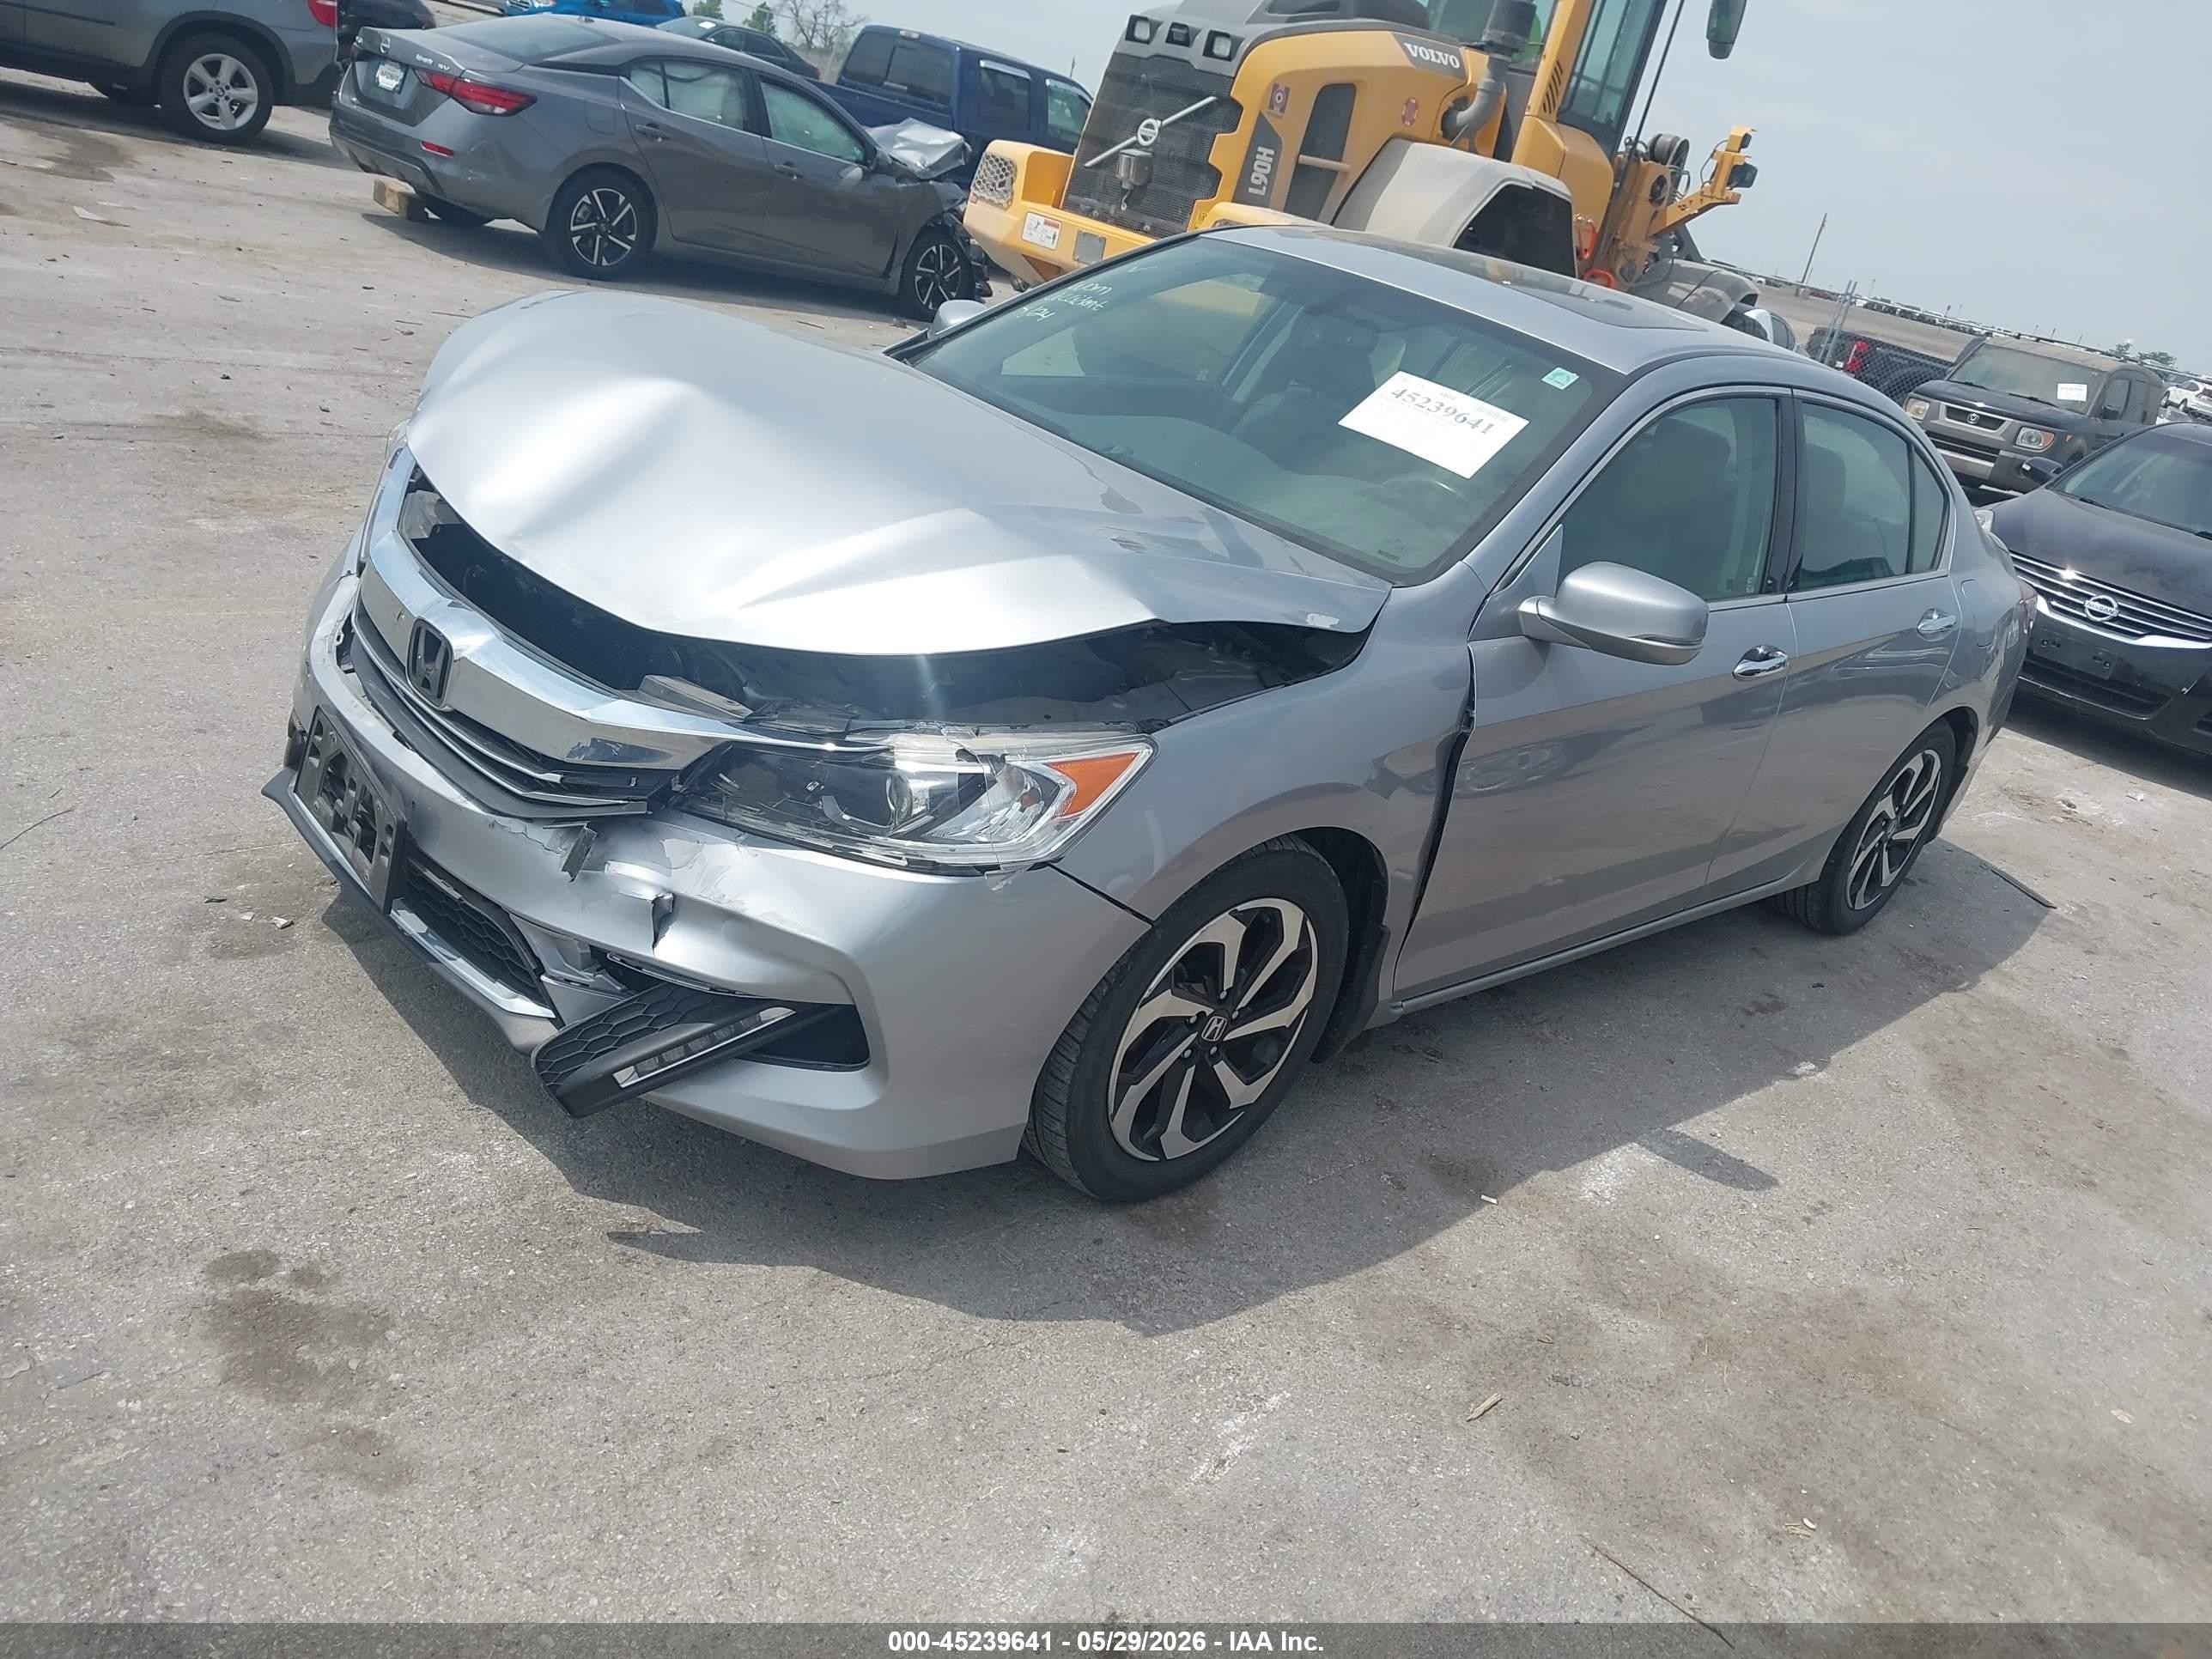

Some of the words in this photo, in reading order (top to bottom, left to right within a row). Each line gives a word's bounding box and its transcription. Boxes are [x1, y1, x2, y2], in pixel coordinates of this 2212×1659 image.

[1403, 42, 1461, 69] VOLVO
[1248, 145, 1275, 196] L90H
[1391, 389, 1495, 434] 45239641
